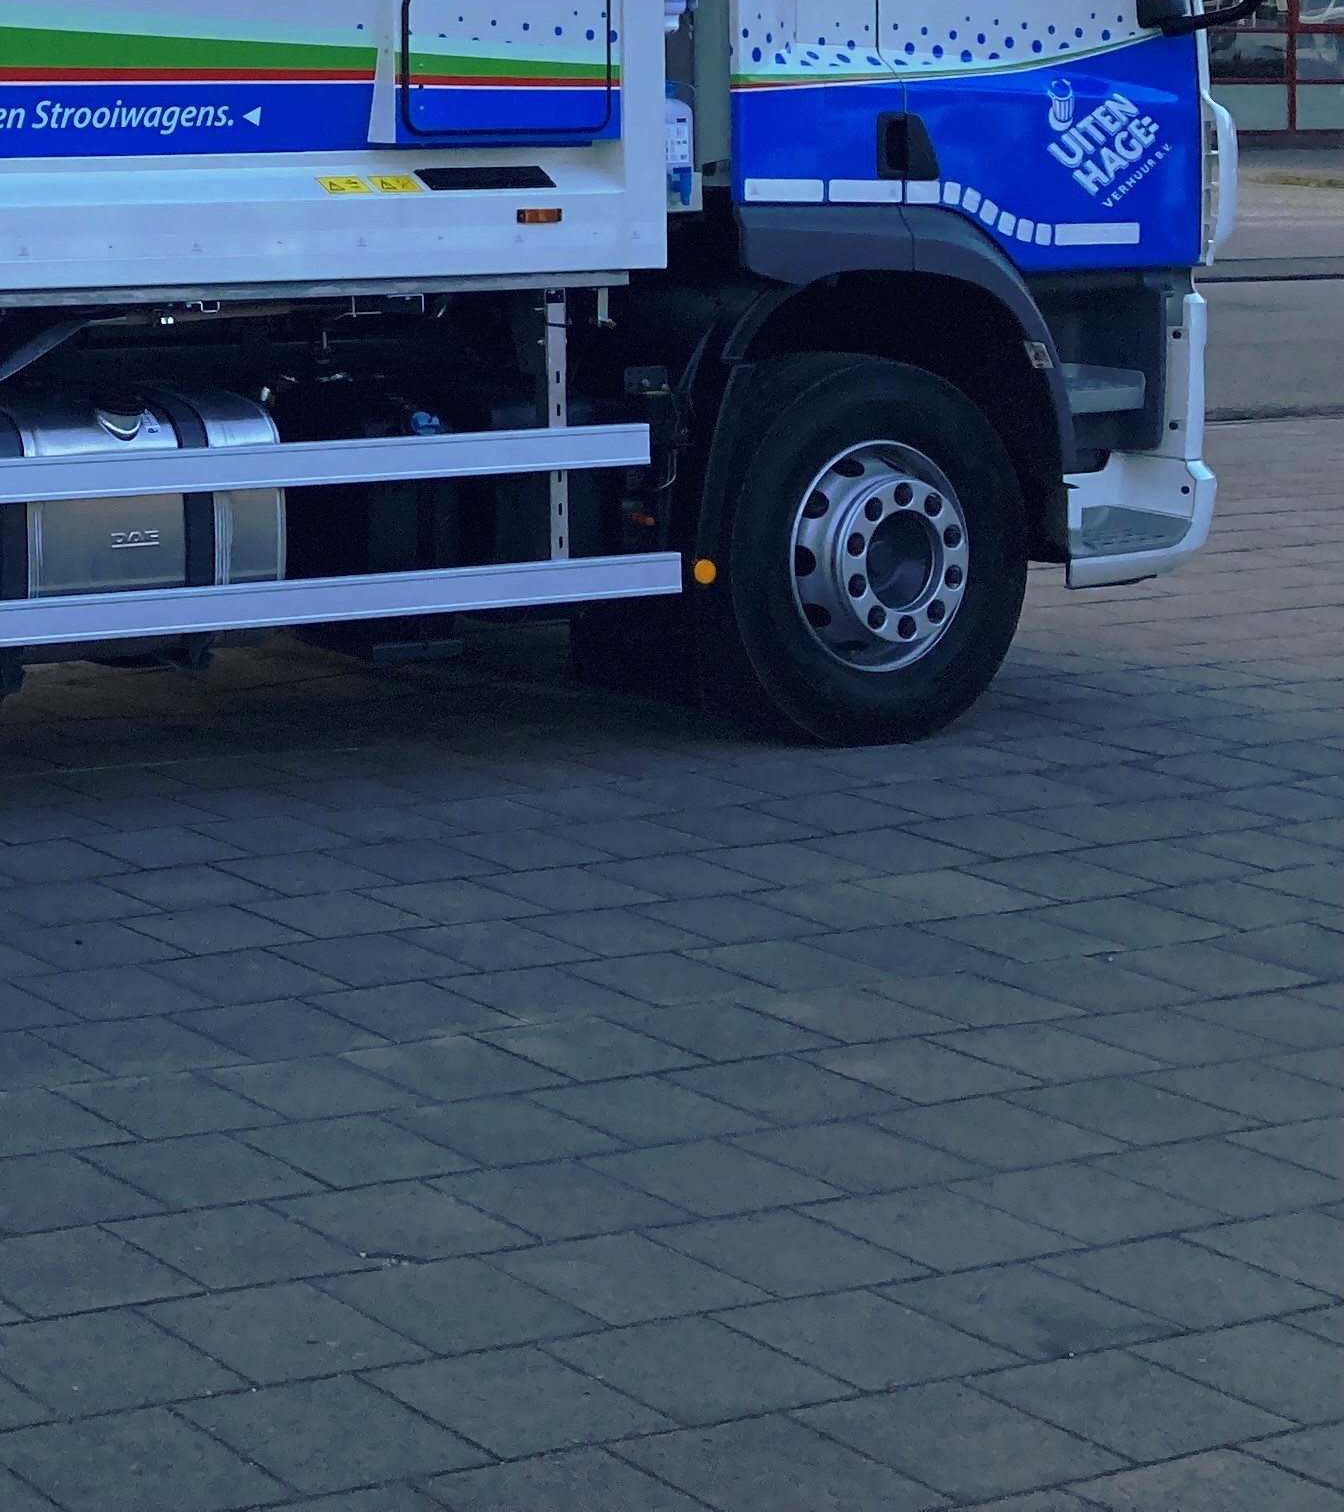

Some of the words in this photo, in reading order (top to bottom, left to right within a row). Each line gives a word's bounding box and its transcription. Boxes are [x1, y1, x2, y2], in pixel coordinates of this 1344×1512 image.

[31, 99, 235, 136] Strooiwagens.
[1047, 92, 1139, 168] UITEN
[1072, 117, 1156, 197] HAGE
[1101, 158, 1157, 207] VERHUUR
